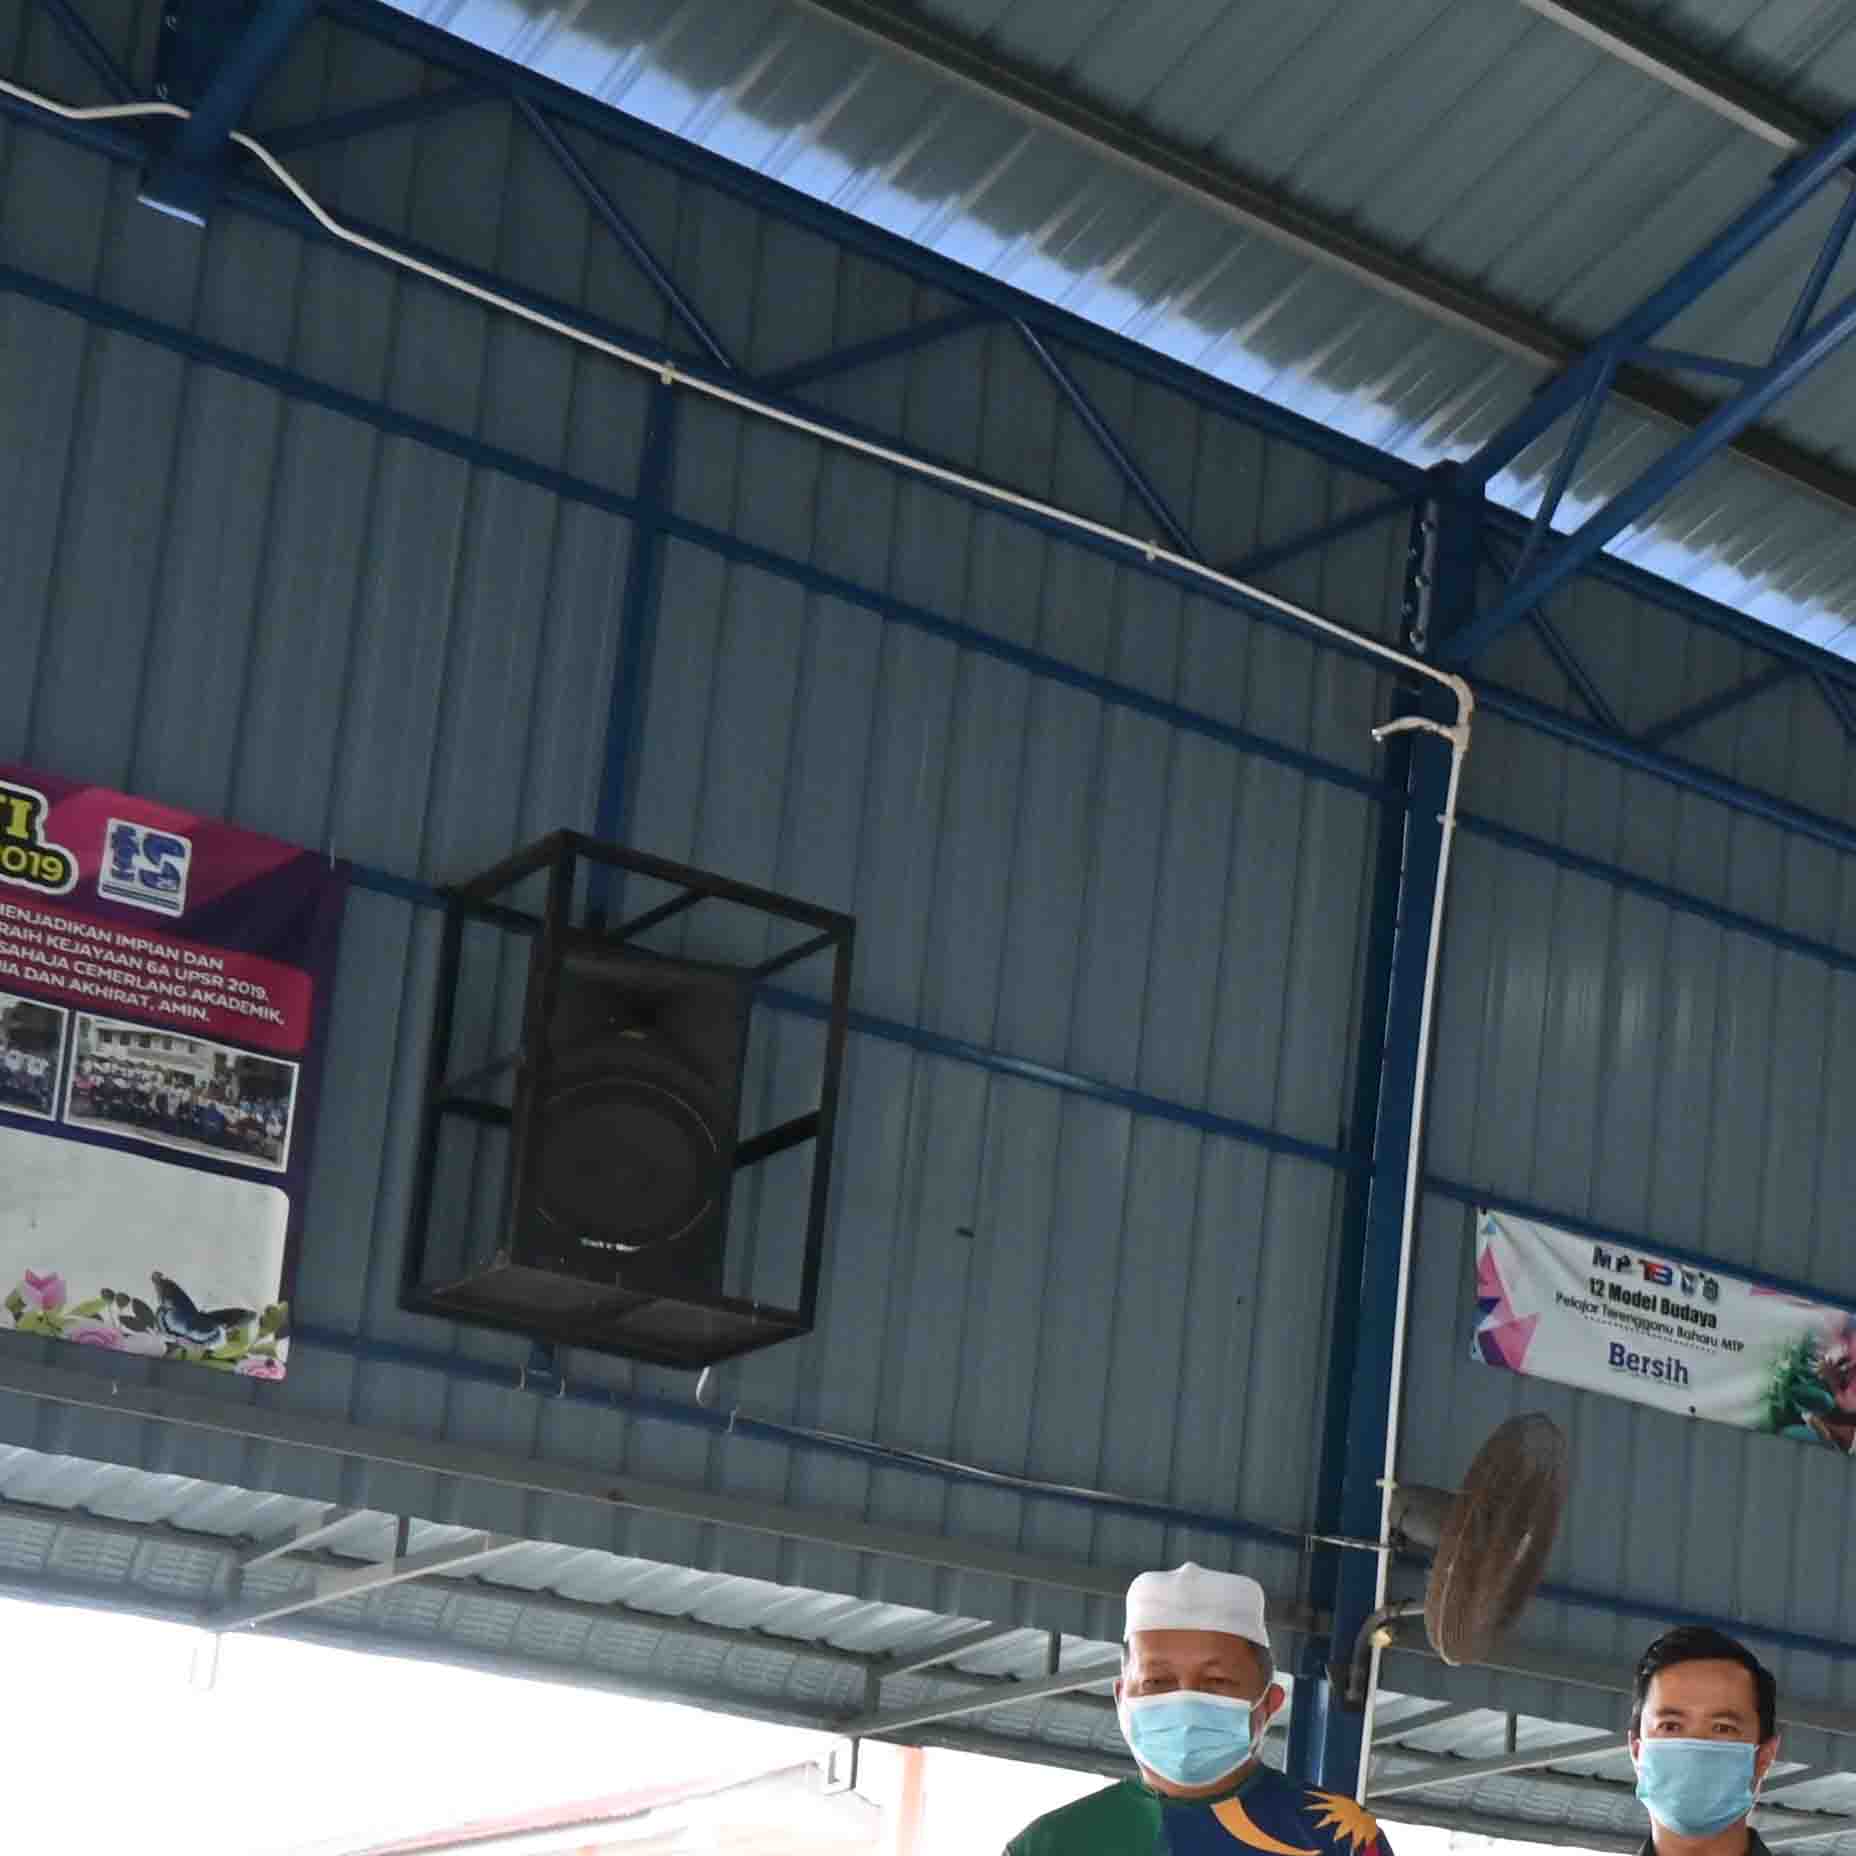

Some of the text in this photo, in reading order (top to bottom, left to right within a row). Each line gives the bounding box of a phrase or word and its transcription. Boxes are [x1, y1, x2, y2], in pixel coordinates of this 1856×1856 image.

[46, 934, 143, 969] KEJAYAAN
[146, 960, 170, 977] 6A
[175, 967, 224, 988] UPSR
[115, 932, 178, 961] IMPIAN
[184, 950, 224, 970] DAN
[24, 966, 65, 986] DAN
[73, 960, 187, 997] CEMERLANG
[1608, 1282, 1657, 1313] Model
[1660, 1298, 1717, 1329] Budaya
[1608, 1341, 1689, 1385] Bersih
